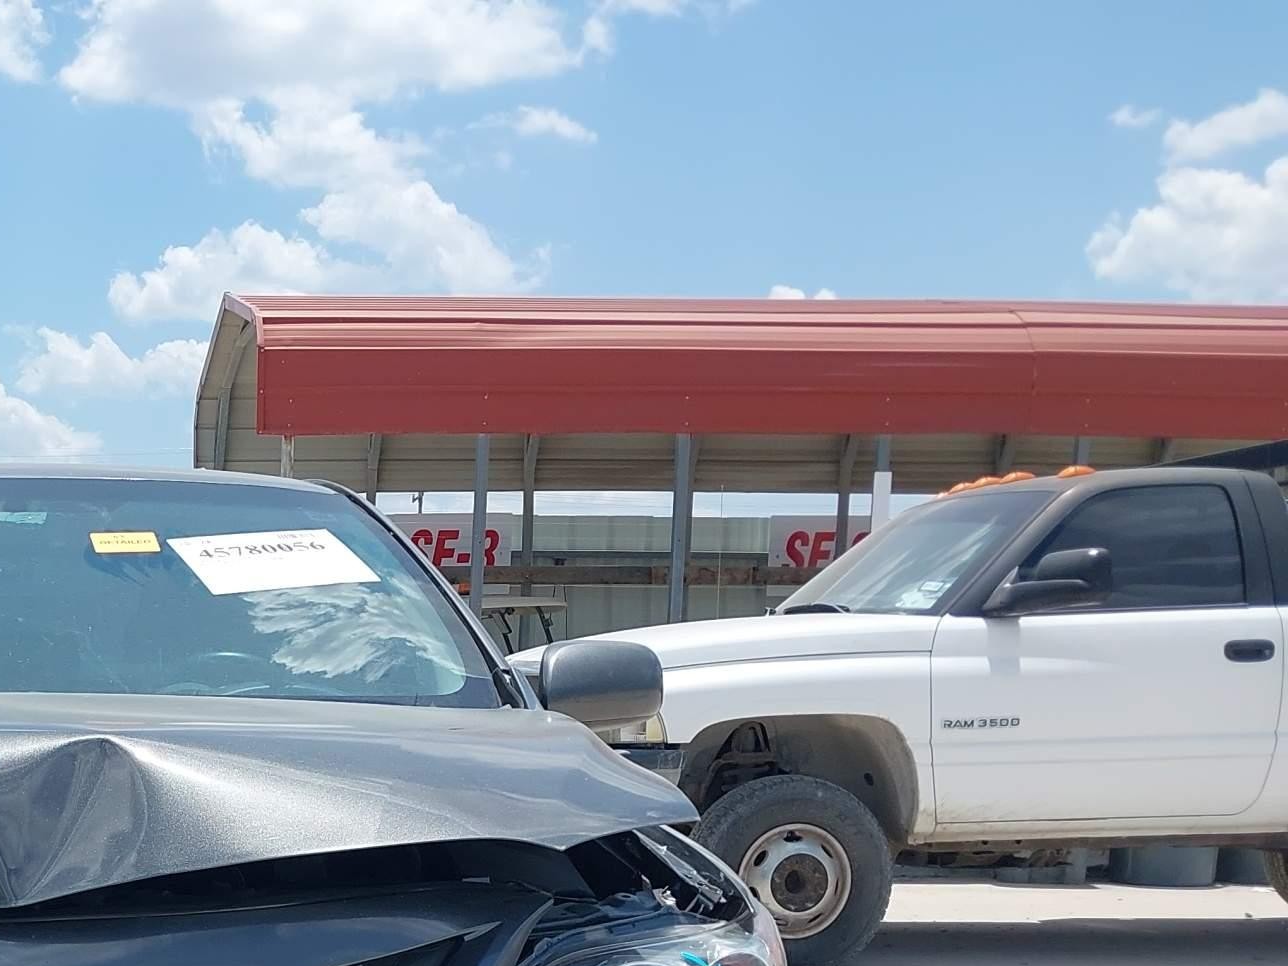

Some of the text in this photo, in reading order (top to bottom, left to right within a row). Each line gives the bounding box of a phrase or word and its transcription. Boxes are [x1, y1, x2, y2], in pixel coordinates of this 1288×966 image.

[199, 541, 326, 559] 45780056
[943, 717, 1020, 729] RAM 3500
